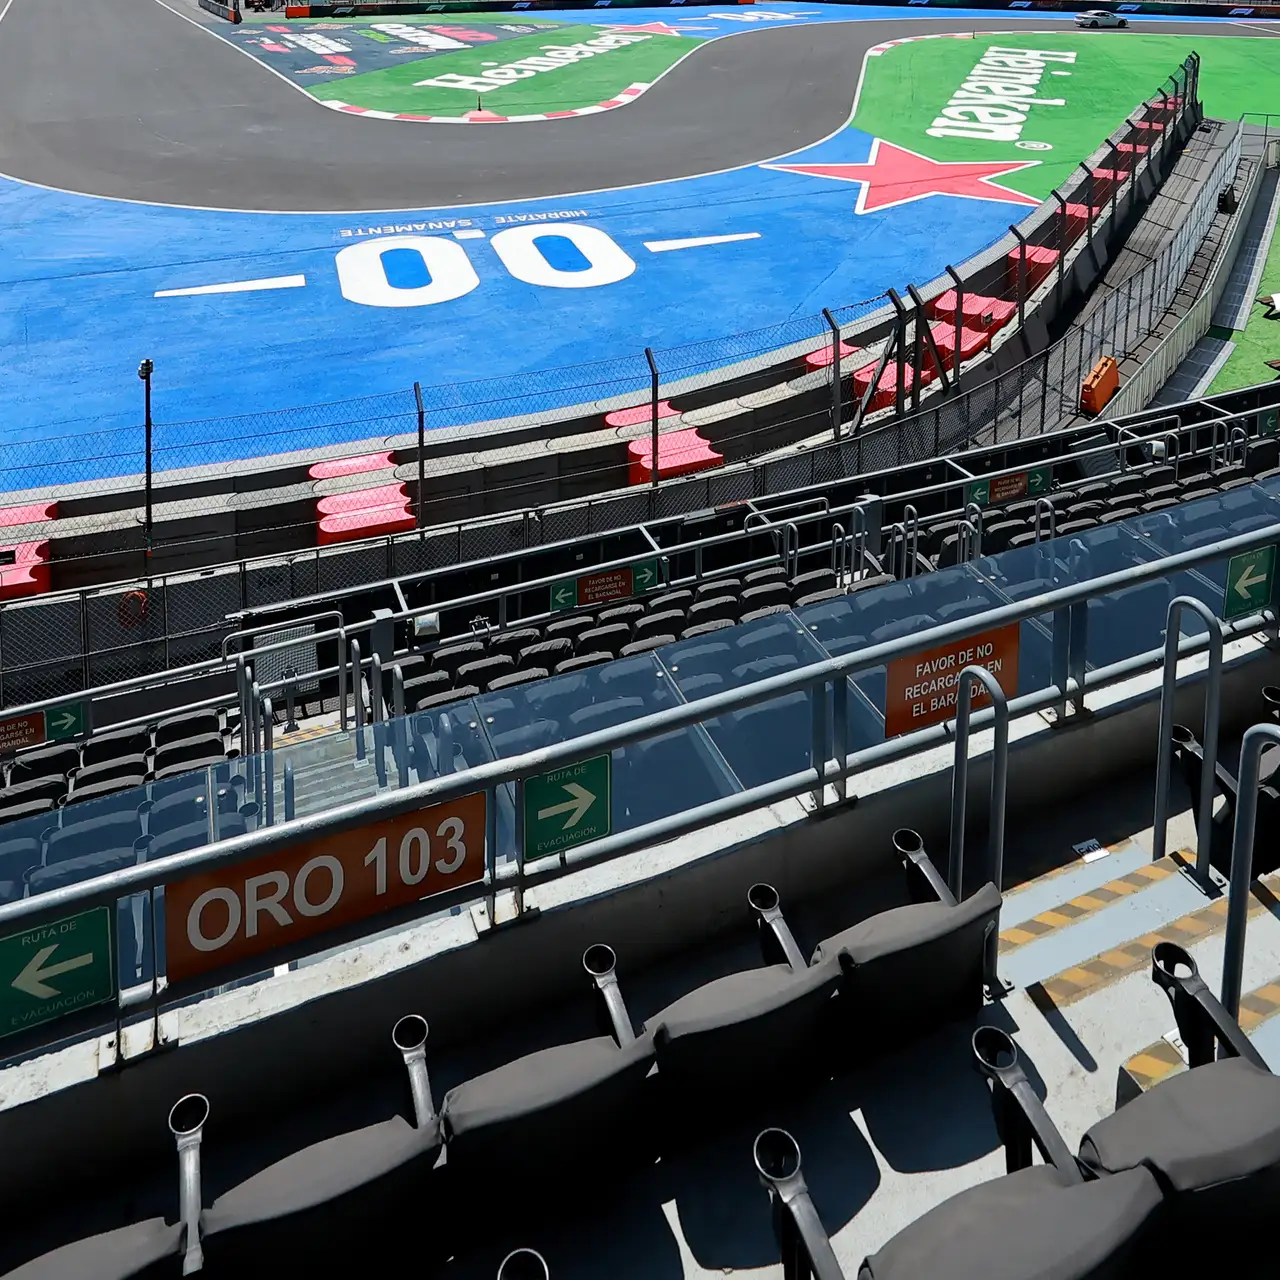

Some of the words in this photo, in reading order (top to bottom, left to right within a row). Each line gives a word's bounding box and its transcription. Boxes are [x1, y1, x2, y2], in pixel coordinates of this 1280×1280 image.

[413, 33, 654, 93] Heineken
[925, 46, 1078, 142] Heineken
[340, 219, 473, 238] SANAMENTE
[495, 209, 588, 224] HIDRATATE
[335, 222, 638, 308] 0.0
[916, 653, 956, 678] FAVOR
[958, 647, 974, 666] DE
[976, 642, 993, 659] NO
[987, 658, 1002, 674] EN
[912, 701, 927, 718] EL
[930, 683, 990, 712] BARADA
[6, 723, 16, 733] DE
[17, 720, 28, 730] NO
[24, 727, 35, 736] EN
[546, 769, 573, 784] RUTA
[573, 765, 587, 776] DE
[537, 825, 598, 852] EVACUACIÓN
[186, 854, 345, 953] ORO
[363, 816, 468, 897] 103
[21, 926, 58, 948] RUTA
[59, 920, 78, 934] DE
[11, 988, 96, 1026] EVACUACIÓN
